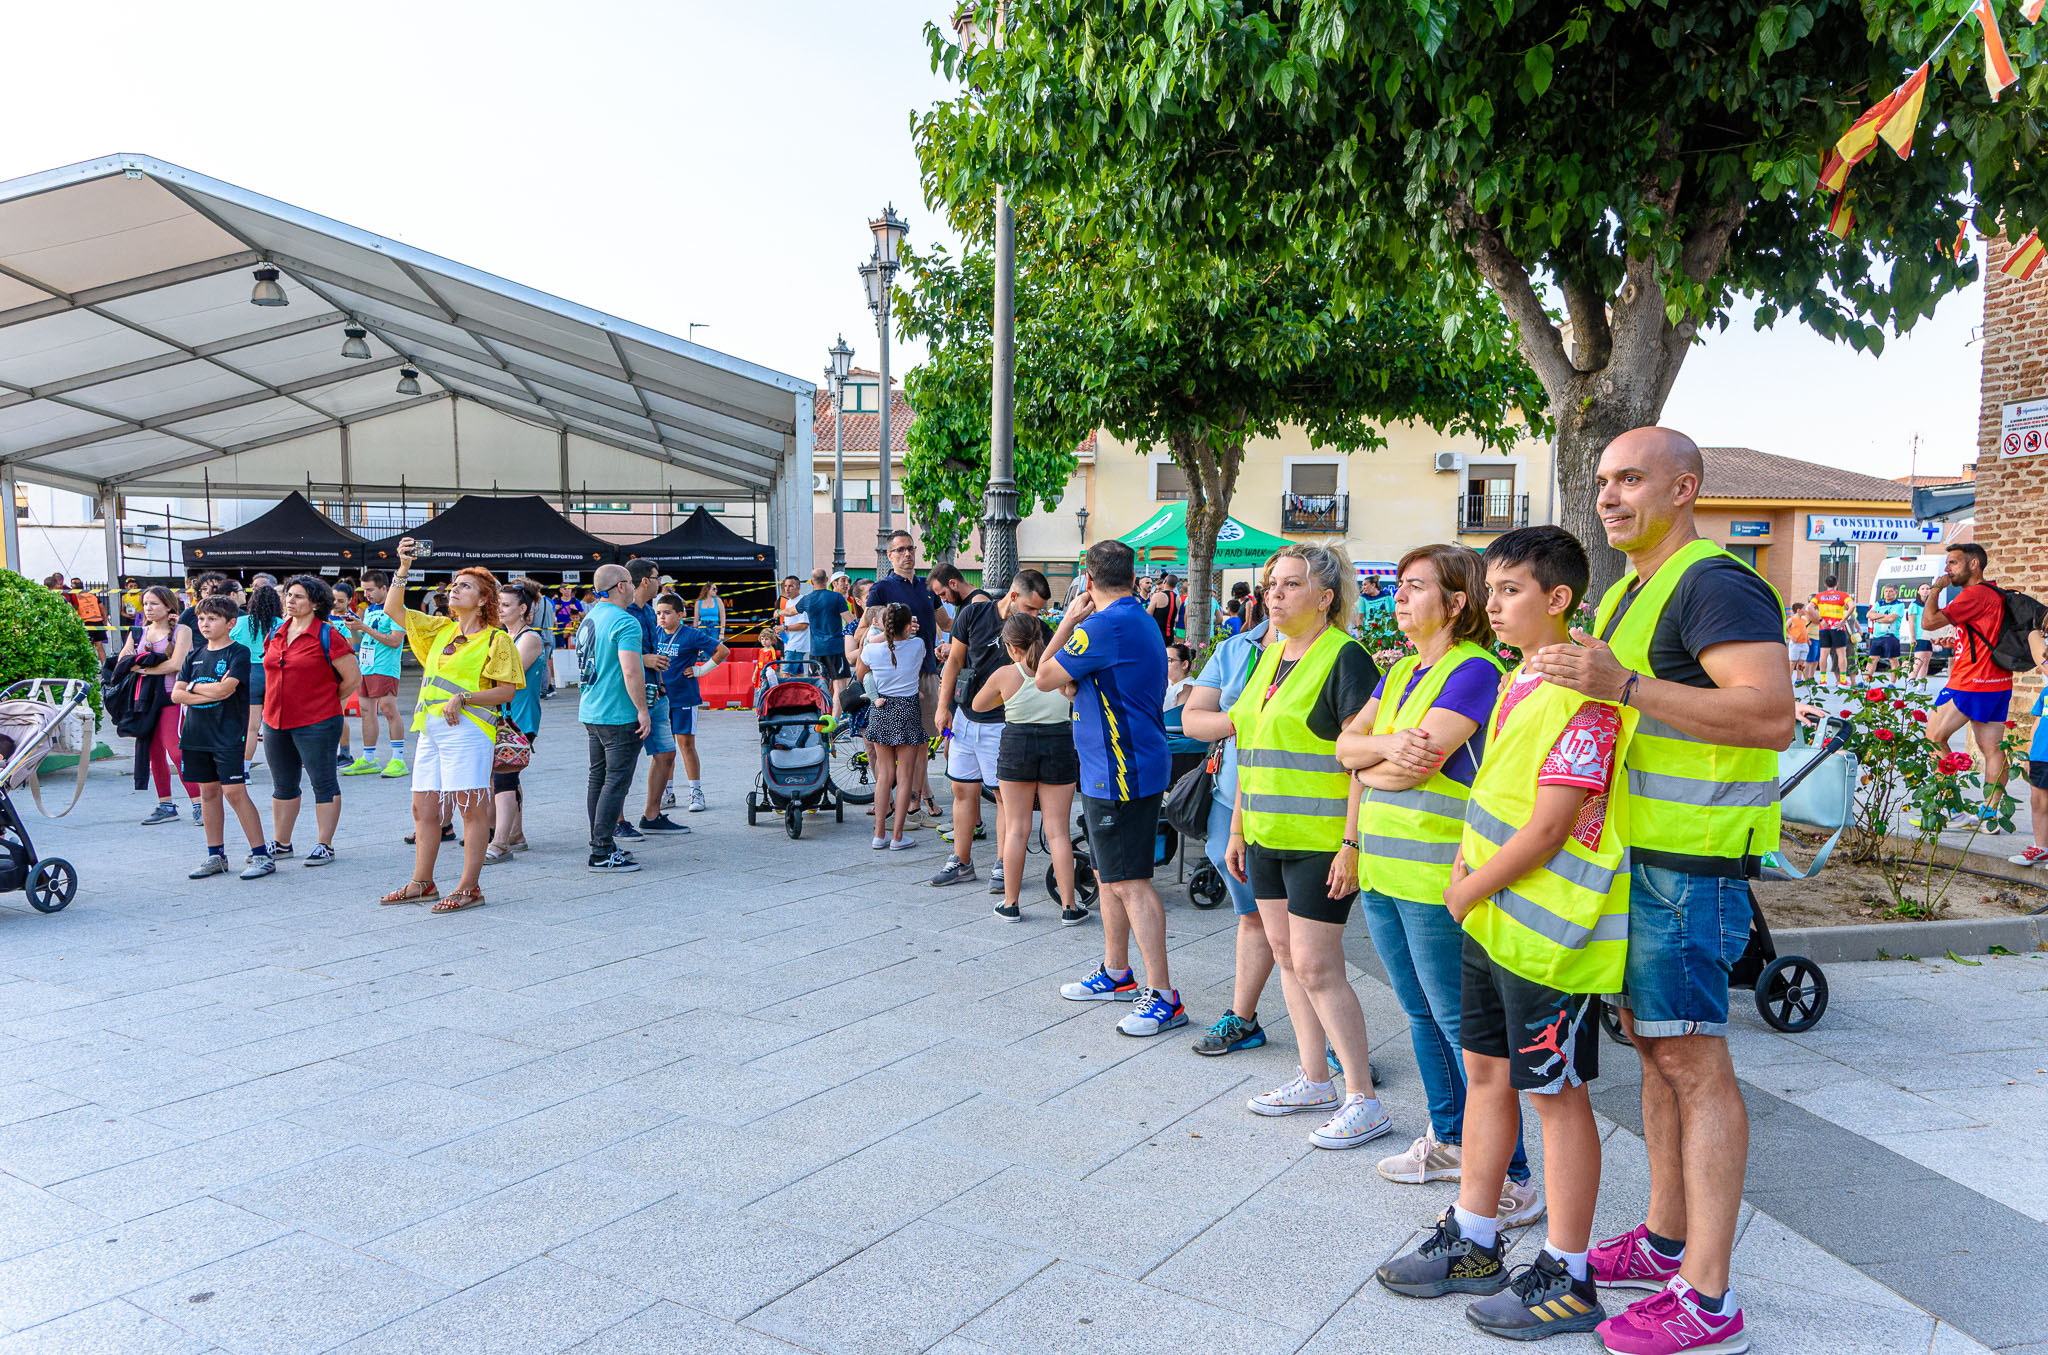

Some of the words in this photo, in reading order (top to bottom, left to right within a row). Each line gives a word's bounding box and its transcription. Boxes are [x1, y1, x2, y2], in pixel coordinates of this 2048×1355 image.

[1833, 517, 1917, 529] CONSULTORIO
[1851, 530, 1898, 540] MEDICO
[1225, 548, 1243, 558] AND
[1245, 547, 1267, 557] WALK
[1566, 729, 1597, 764] hp
[1449, 1260, 1499, 1279] adidas
[1661, 1312, 1705, 1347] N
